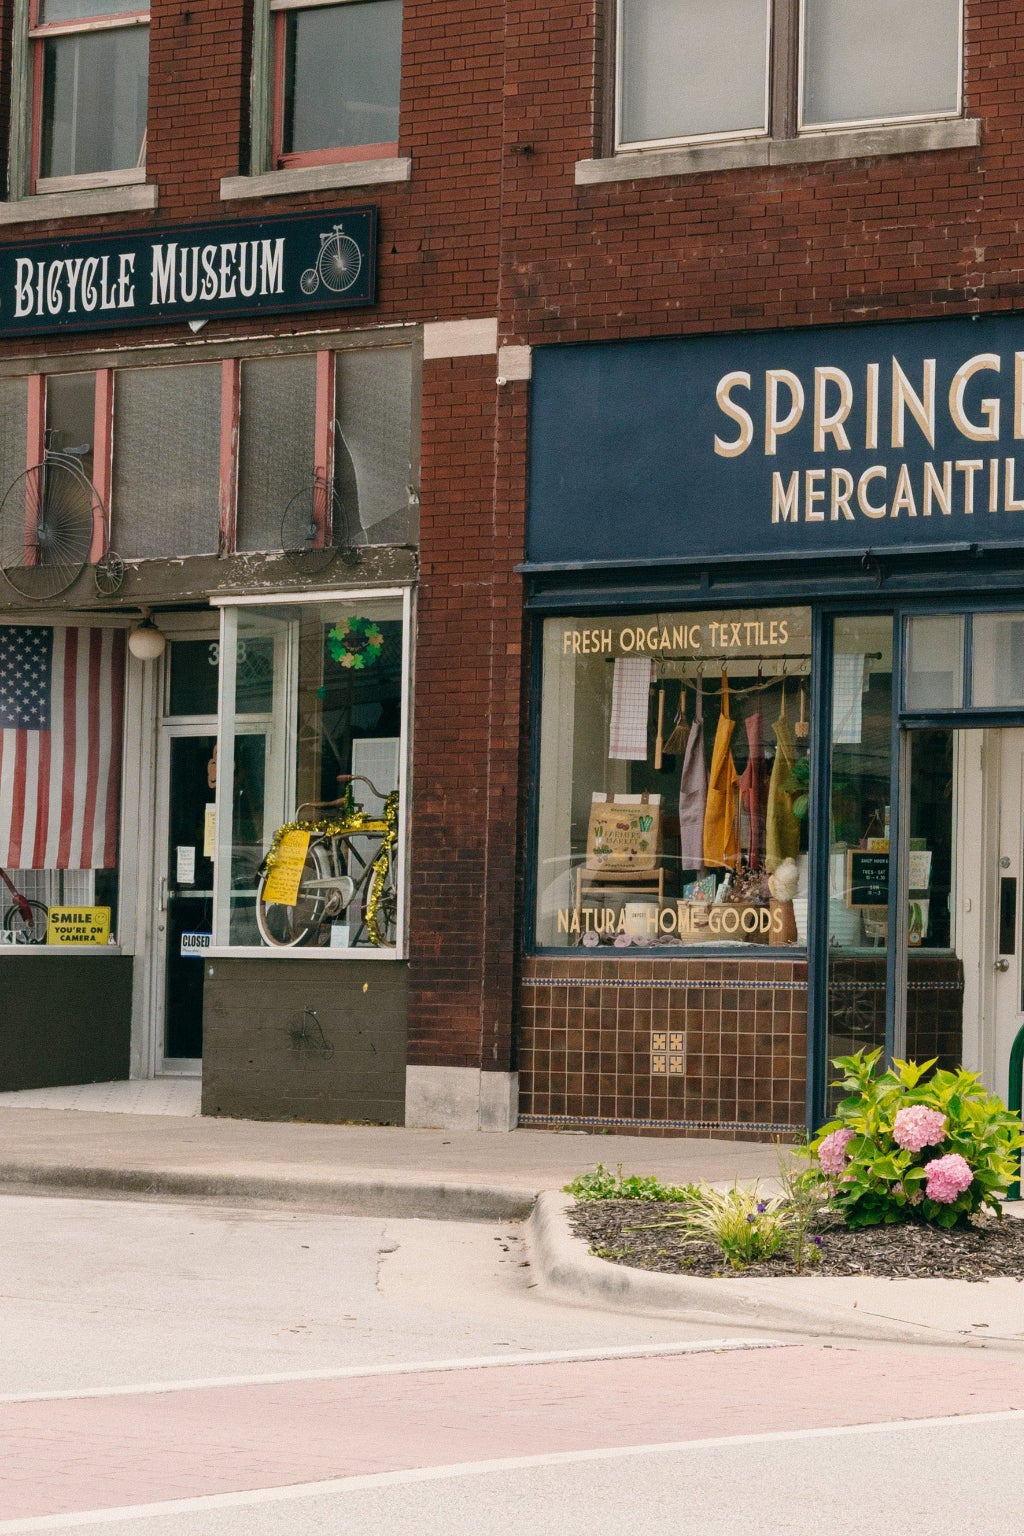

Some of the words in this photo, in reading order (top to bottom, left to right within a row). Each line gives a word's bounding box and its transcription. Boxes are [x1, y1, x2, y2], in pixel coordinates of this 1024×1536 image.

[14, 253, 136, 318] BICYCLE
[150, 237, 286, 306] MUSEUM
[563, 628, 612, 655] FRESH
[619, 624, 701, 652] ORGANIC
[708, 620, 789, 648] TEXTILES
[51, 913, 92, 923] SMILE
[557, 908, 639, 933] NATURAL
[647, 908, 700, 933] HOME
[708, 907, 783, 934] GOODS
[54, 926, 86, 934] YOU'RE
[90, 926, 103, 934] ON
[182, 934, 210, 948] CLOSED
